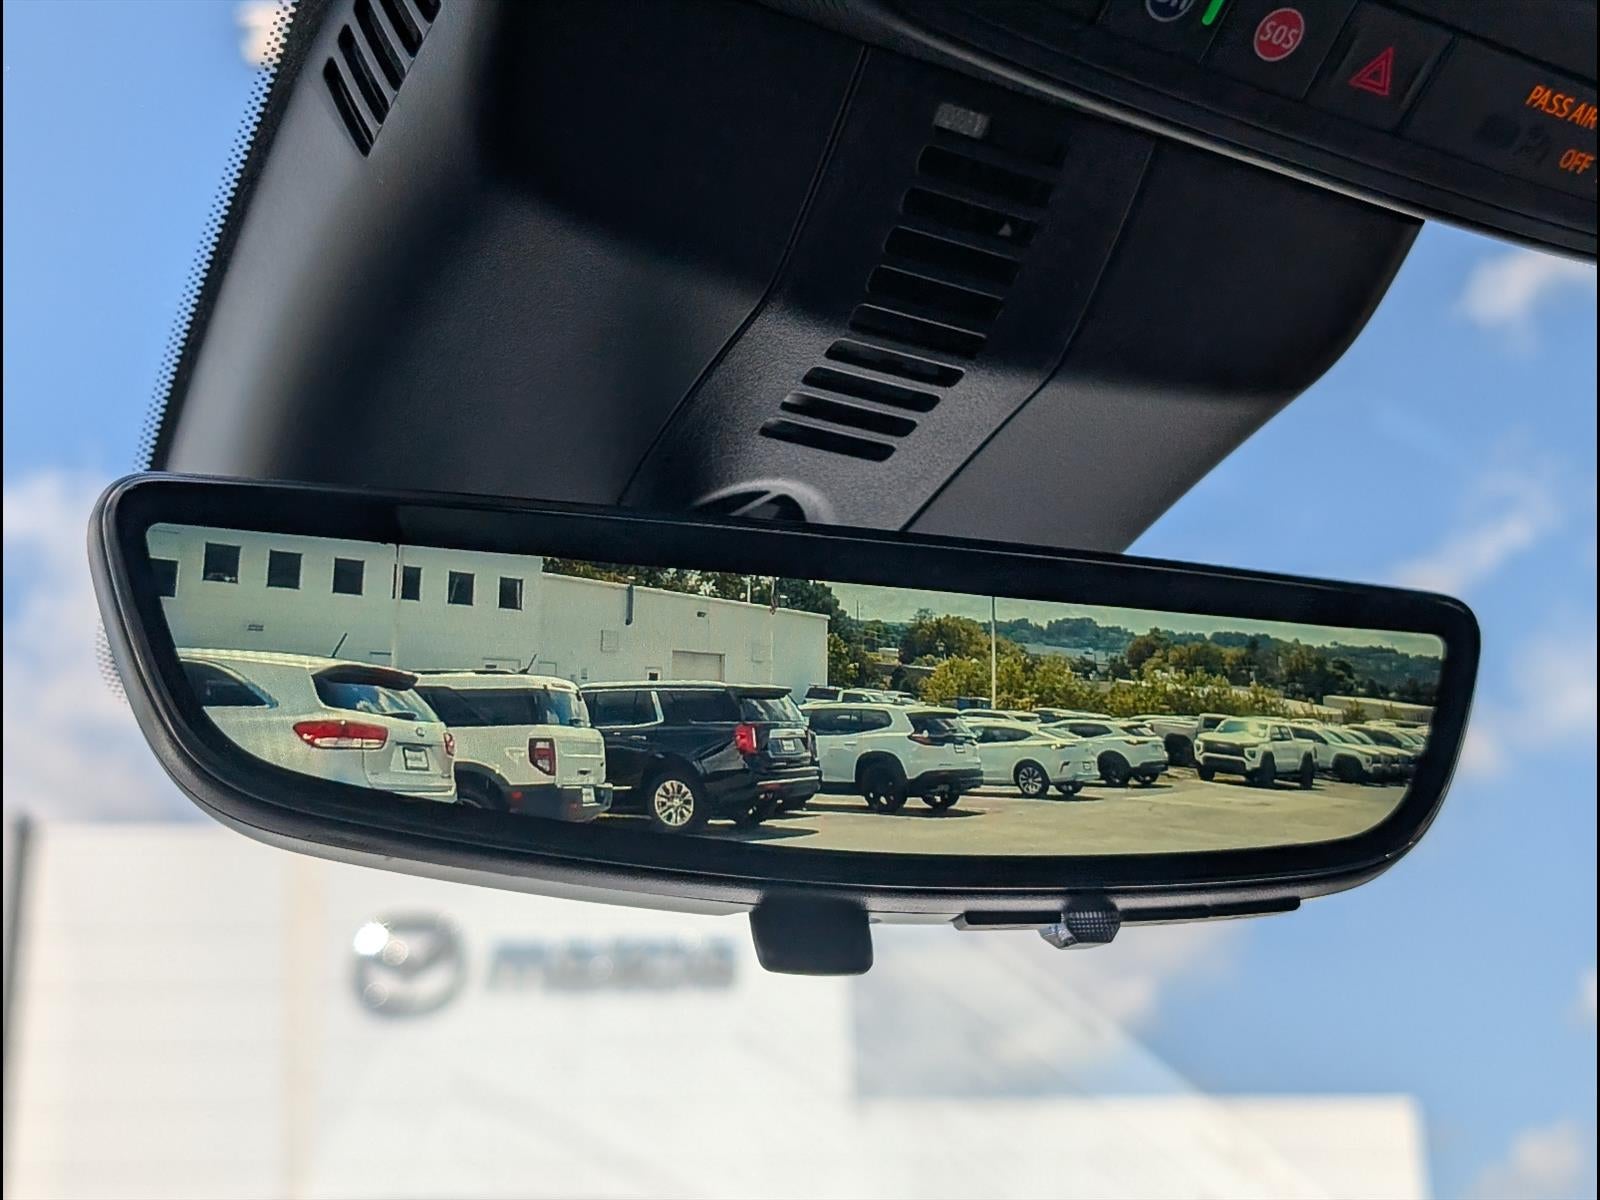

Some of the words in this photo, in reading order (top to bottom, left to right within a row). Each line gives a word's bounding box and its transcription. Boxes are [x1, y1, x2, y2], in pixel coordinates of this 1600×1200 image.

[1259, 20, 1299, 49] SOS
[1525, 85, 1575, 118] PASS
[1559, 149, 1595, 174] OFF
